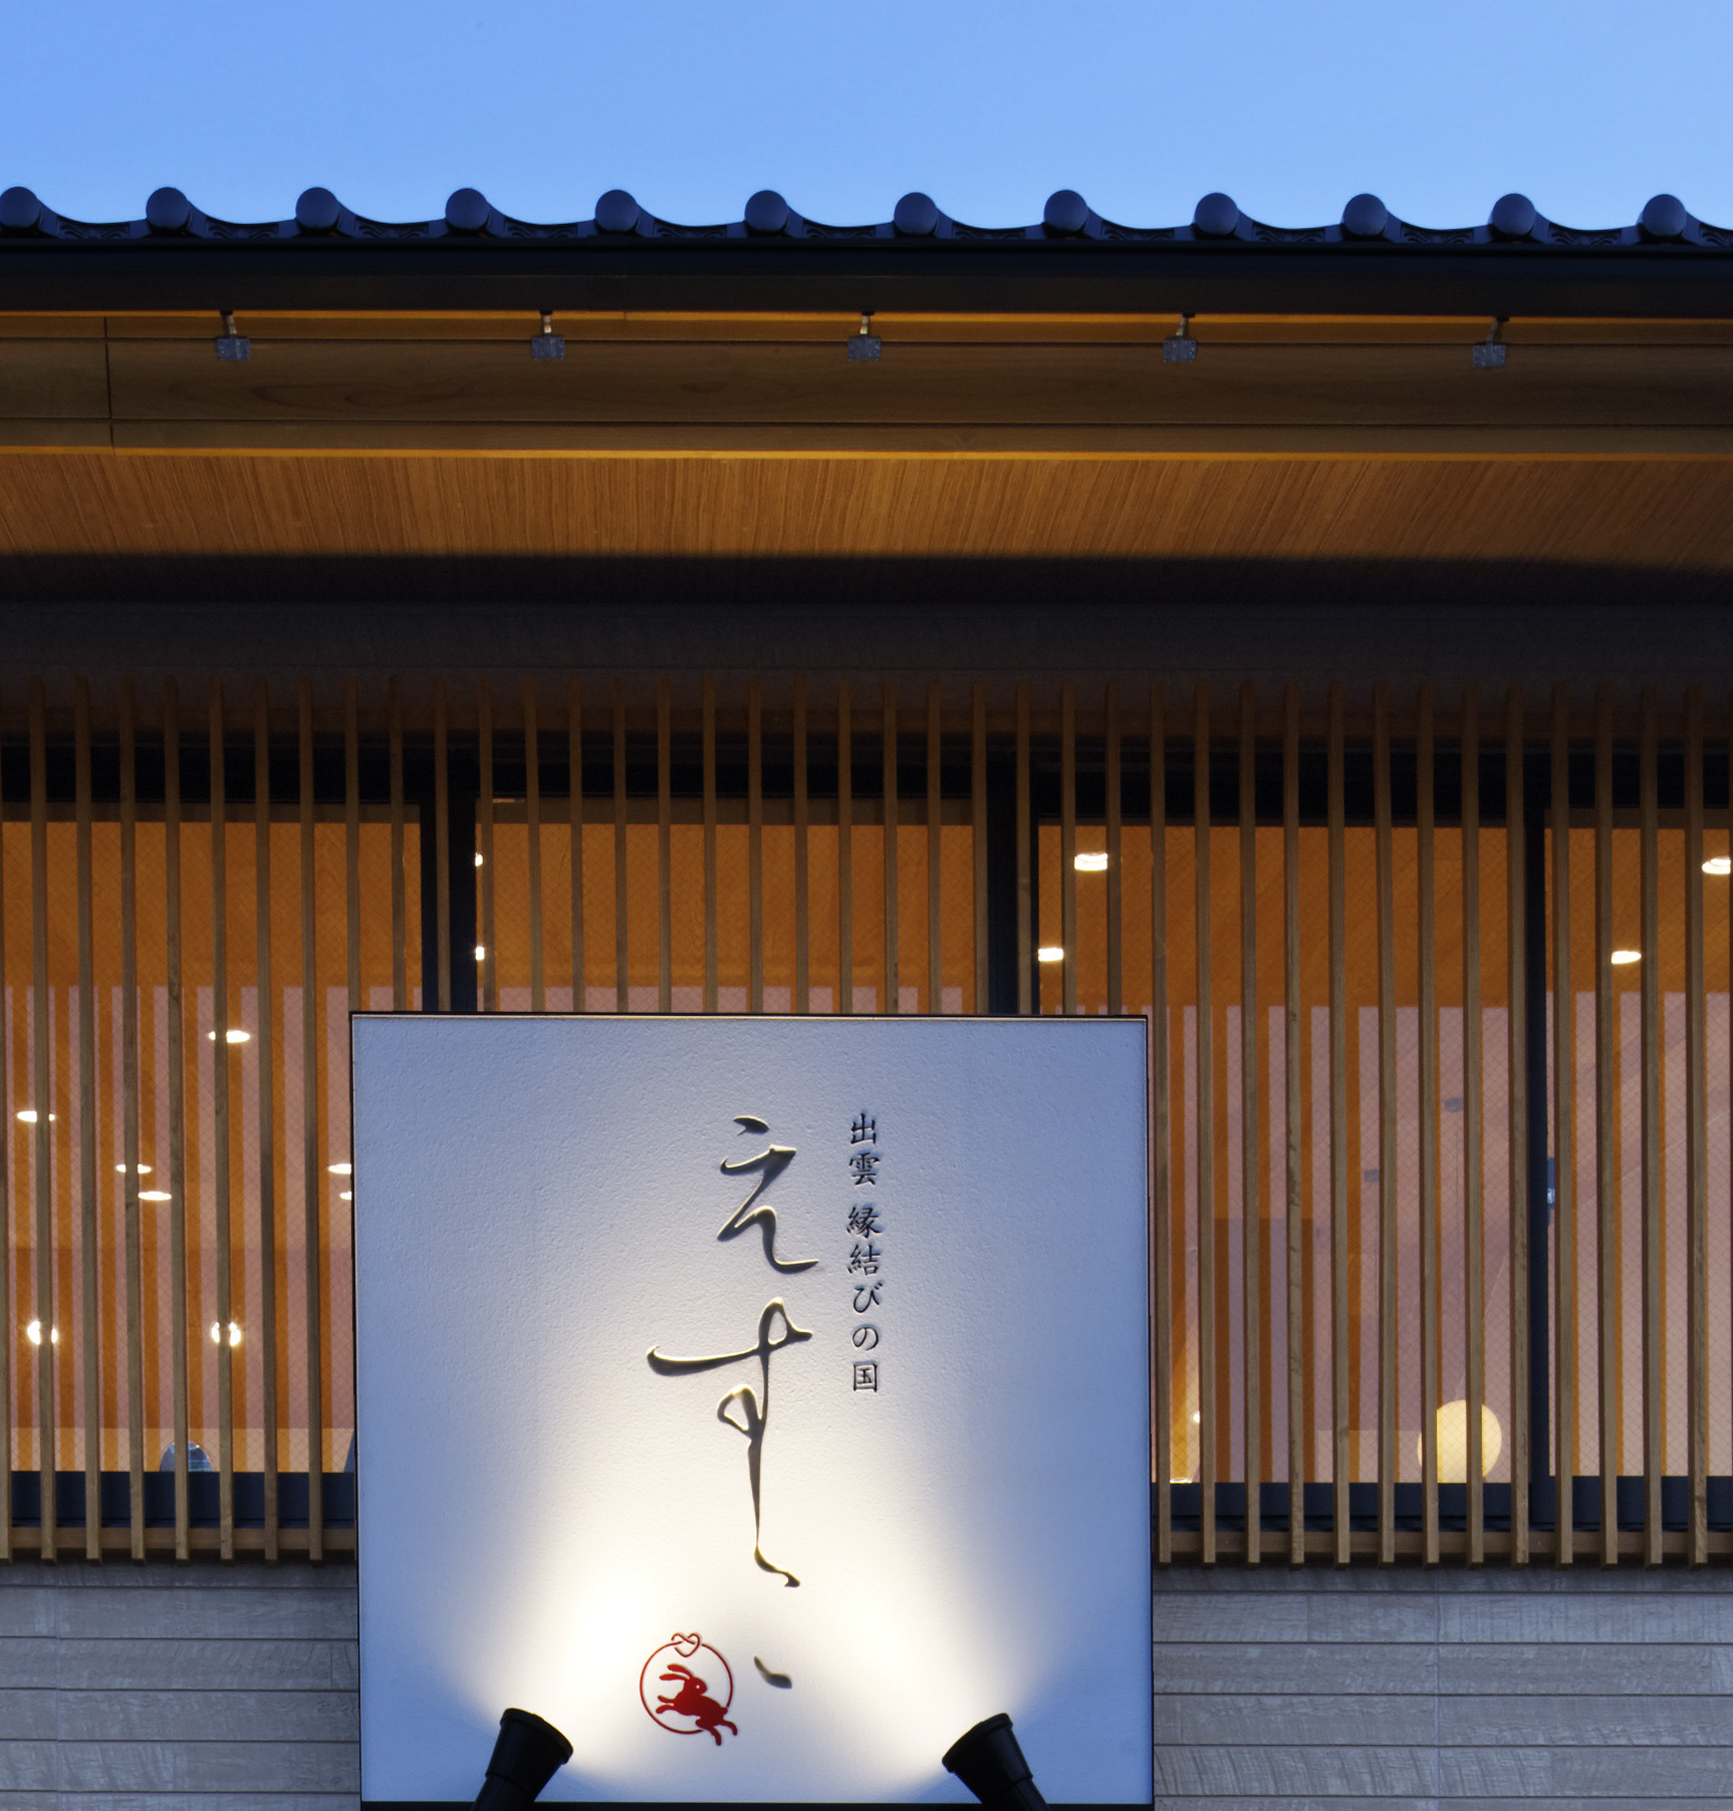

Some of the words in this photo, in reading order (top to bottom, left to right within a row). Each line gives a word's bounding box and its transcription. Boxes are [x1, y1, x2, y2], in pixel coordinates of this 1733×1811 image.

[848, 1112, 881, 1186] 出雲
[845, 1206, 884, 1393] 縁結びの国
